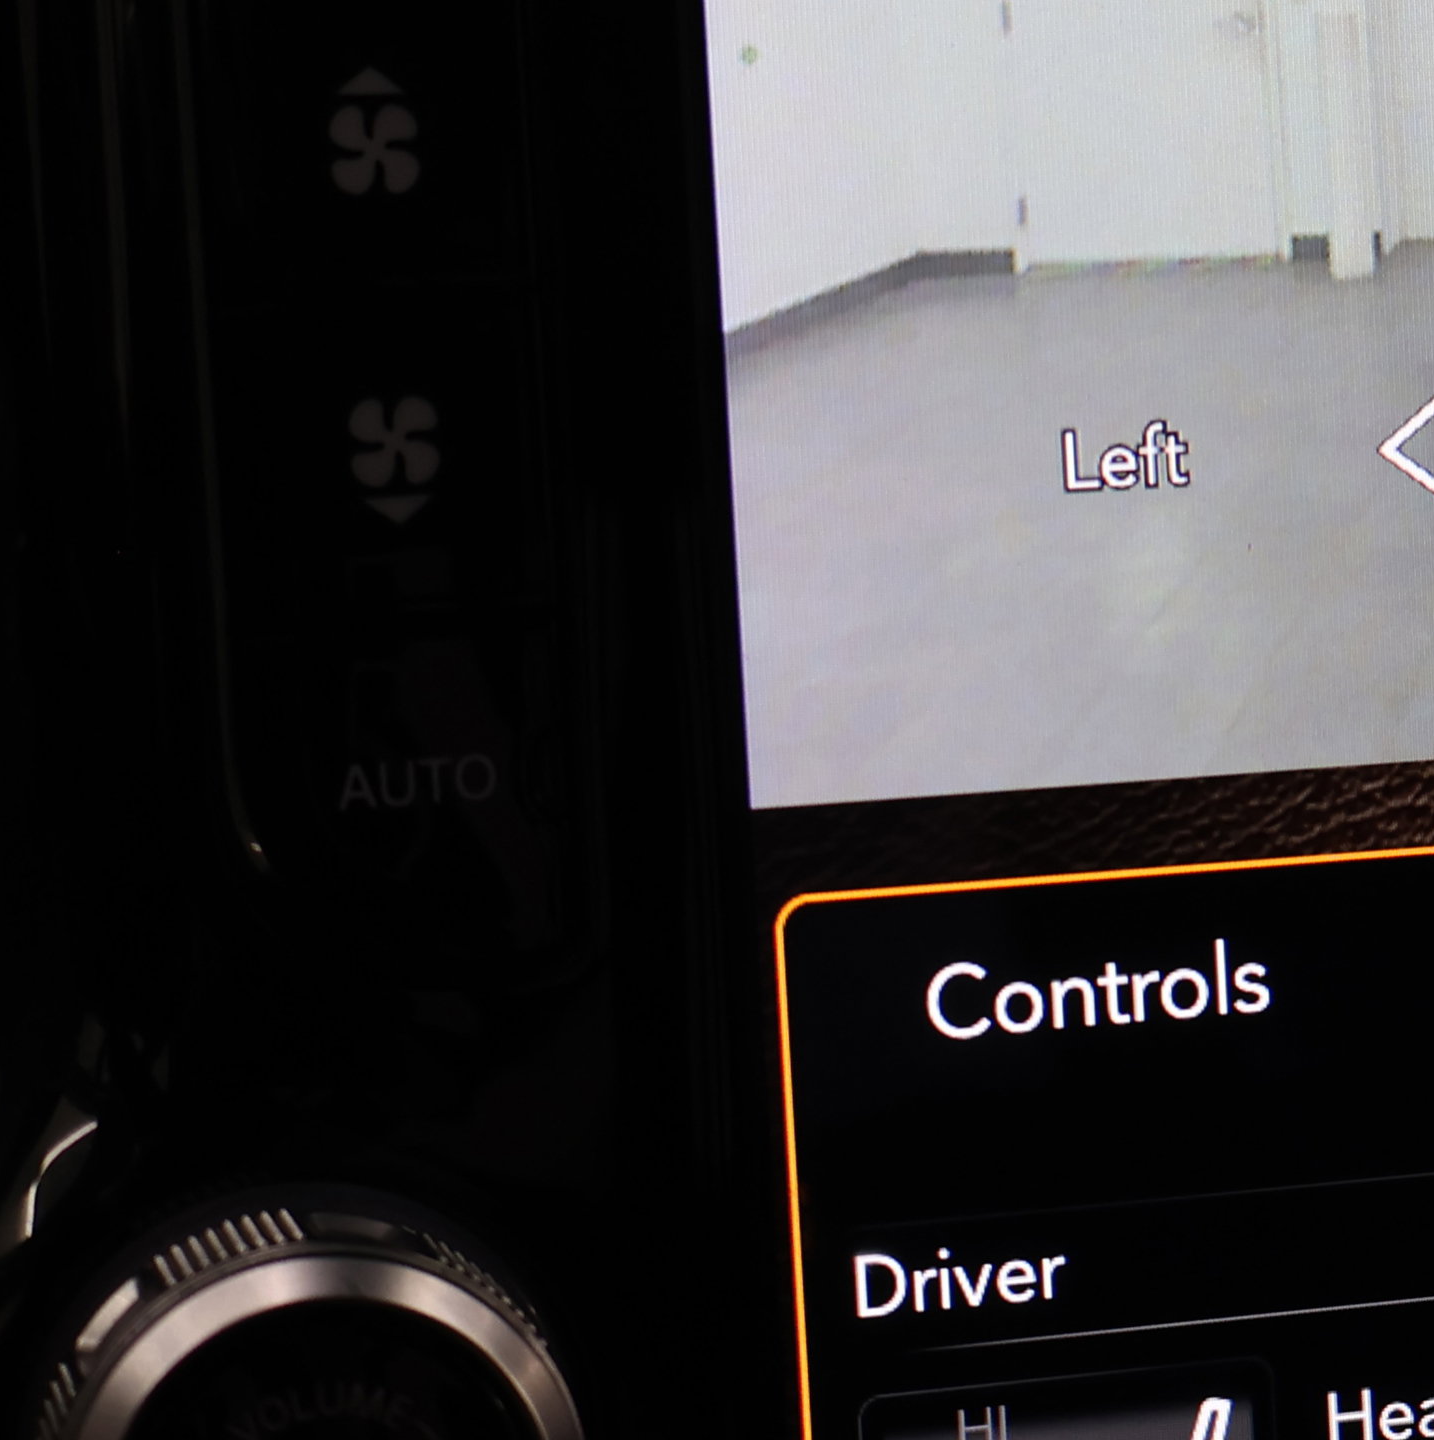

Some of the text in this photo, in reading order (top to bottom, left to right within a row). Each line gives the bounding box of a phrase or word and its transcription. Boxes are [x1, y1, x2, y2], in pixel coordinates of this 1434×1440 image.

[1060, 424, 1192, 498] Left
[337, 752, 500, 813] AUTO
[925, 938, 1271, 1041] Controls
[853, 1247, 1068, 1320] Driver
